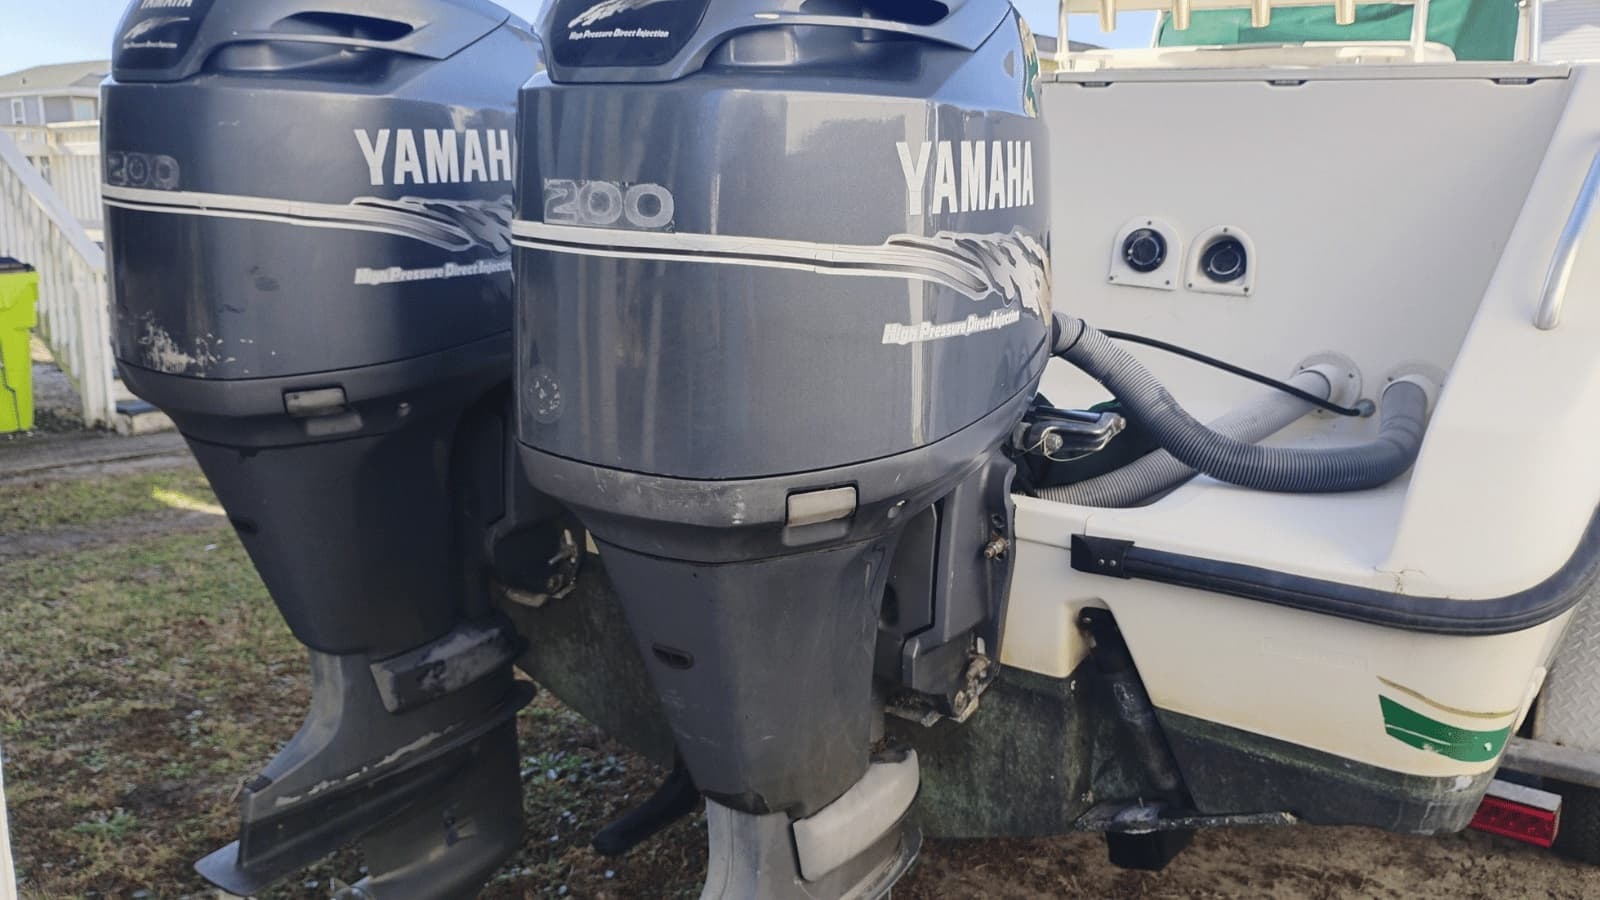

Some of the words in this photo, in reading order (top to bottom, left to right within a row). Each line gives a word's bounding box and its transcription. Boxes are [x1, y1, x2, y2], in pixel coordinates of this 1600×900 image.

[613, 28, 636, 37] Direct
[636, 28, 669, 38] Injection
[106, 152, 180, 189] 200
[353, 128, 512, 185] YAMAH
[896, 140, 1034, 215] YAMAHA
[543, 179, 675, 228] 200
[390, 267, 443, 282] Pressure
[444, 262, 477, 278] Direct
[882, 322, 919, 345] High
[919, 320, 966, 340] Pressure
[966, 313, 992, 334] Direct
[992, 309, 1020, 329] Injection
